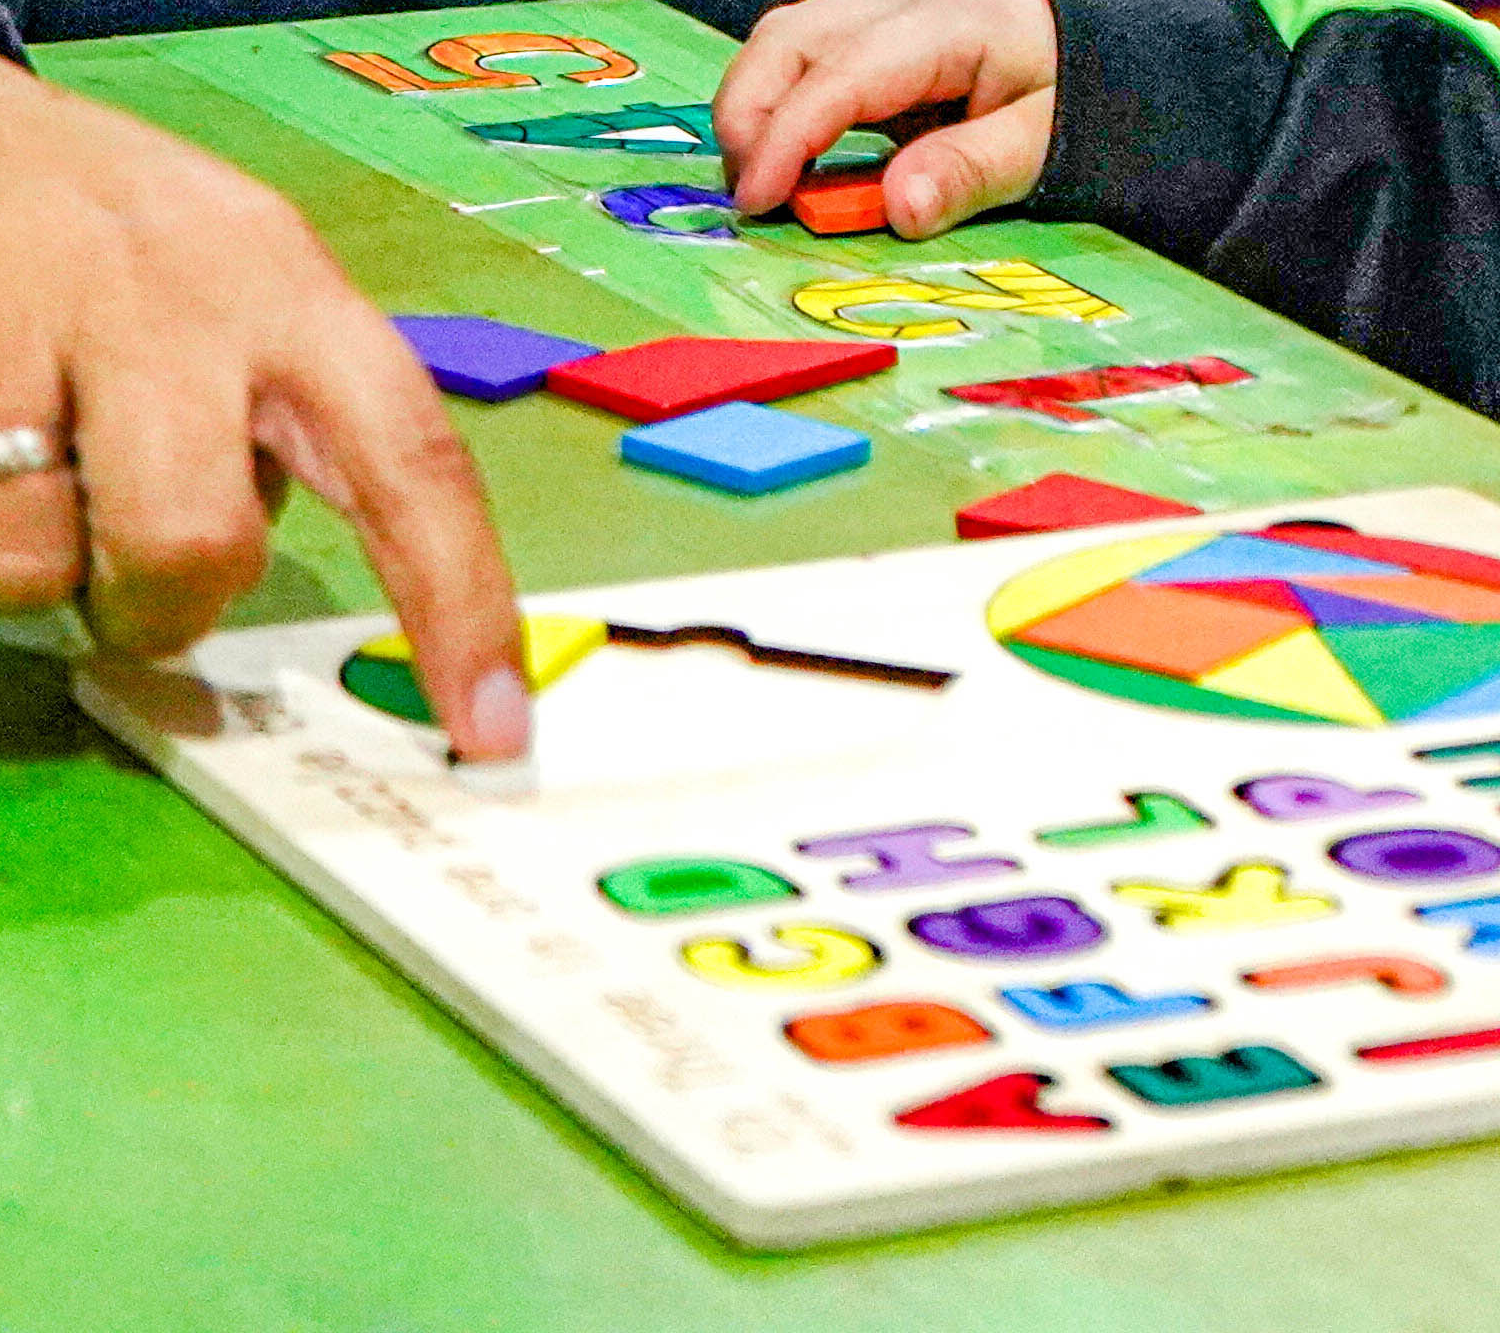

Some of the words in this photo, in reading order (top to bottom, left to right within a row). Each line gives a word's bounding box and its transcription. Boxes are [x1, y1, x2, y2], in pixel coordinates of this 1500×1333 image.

[322, 31, 640, 96] 5
[792, 258, 1132, 341] 2
[940, 353, 1258, 425] 1
[1033, 789, 1216, 845] L
[1232, 773, 1418, 821] P
[597, 857, 802, 917] D
[793, 821, 1024, 893] H
[906, 896, 1106, 958] G
[1110, 860, 1338, 931] K
[679, 923, 884, 988] C
[1240, 955, 1448, 999] J
[782, 998, 994, 1067] B
[999, 980, 1216, 1030] F
[891, 1069, 1111, 1136] A
[1102, 1045, 1322, 1108] E
